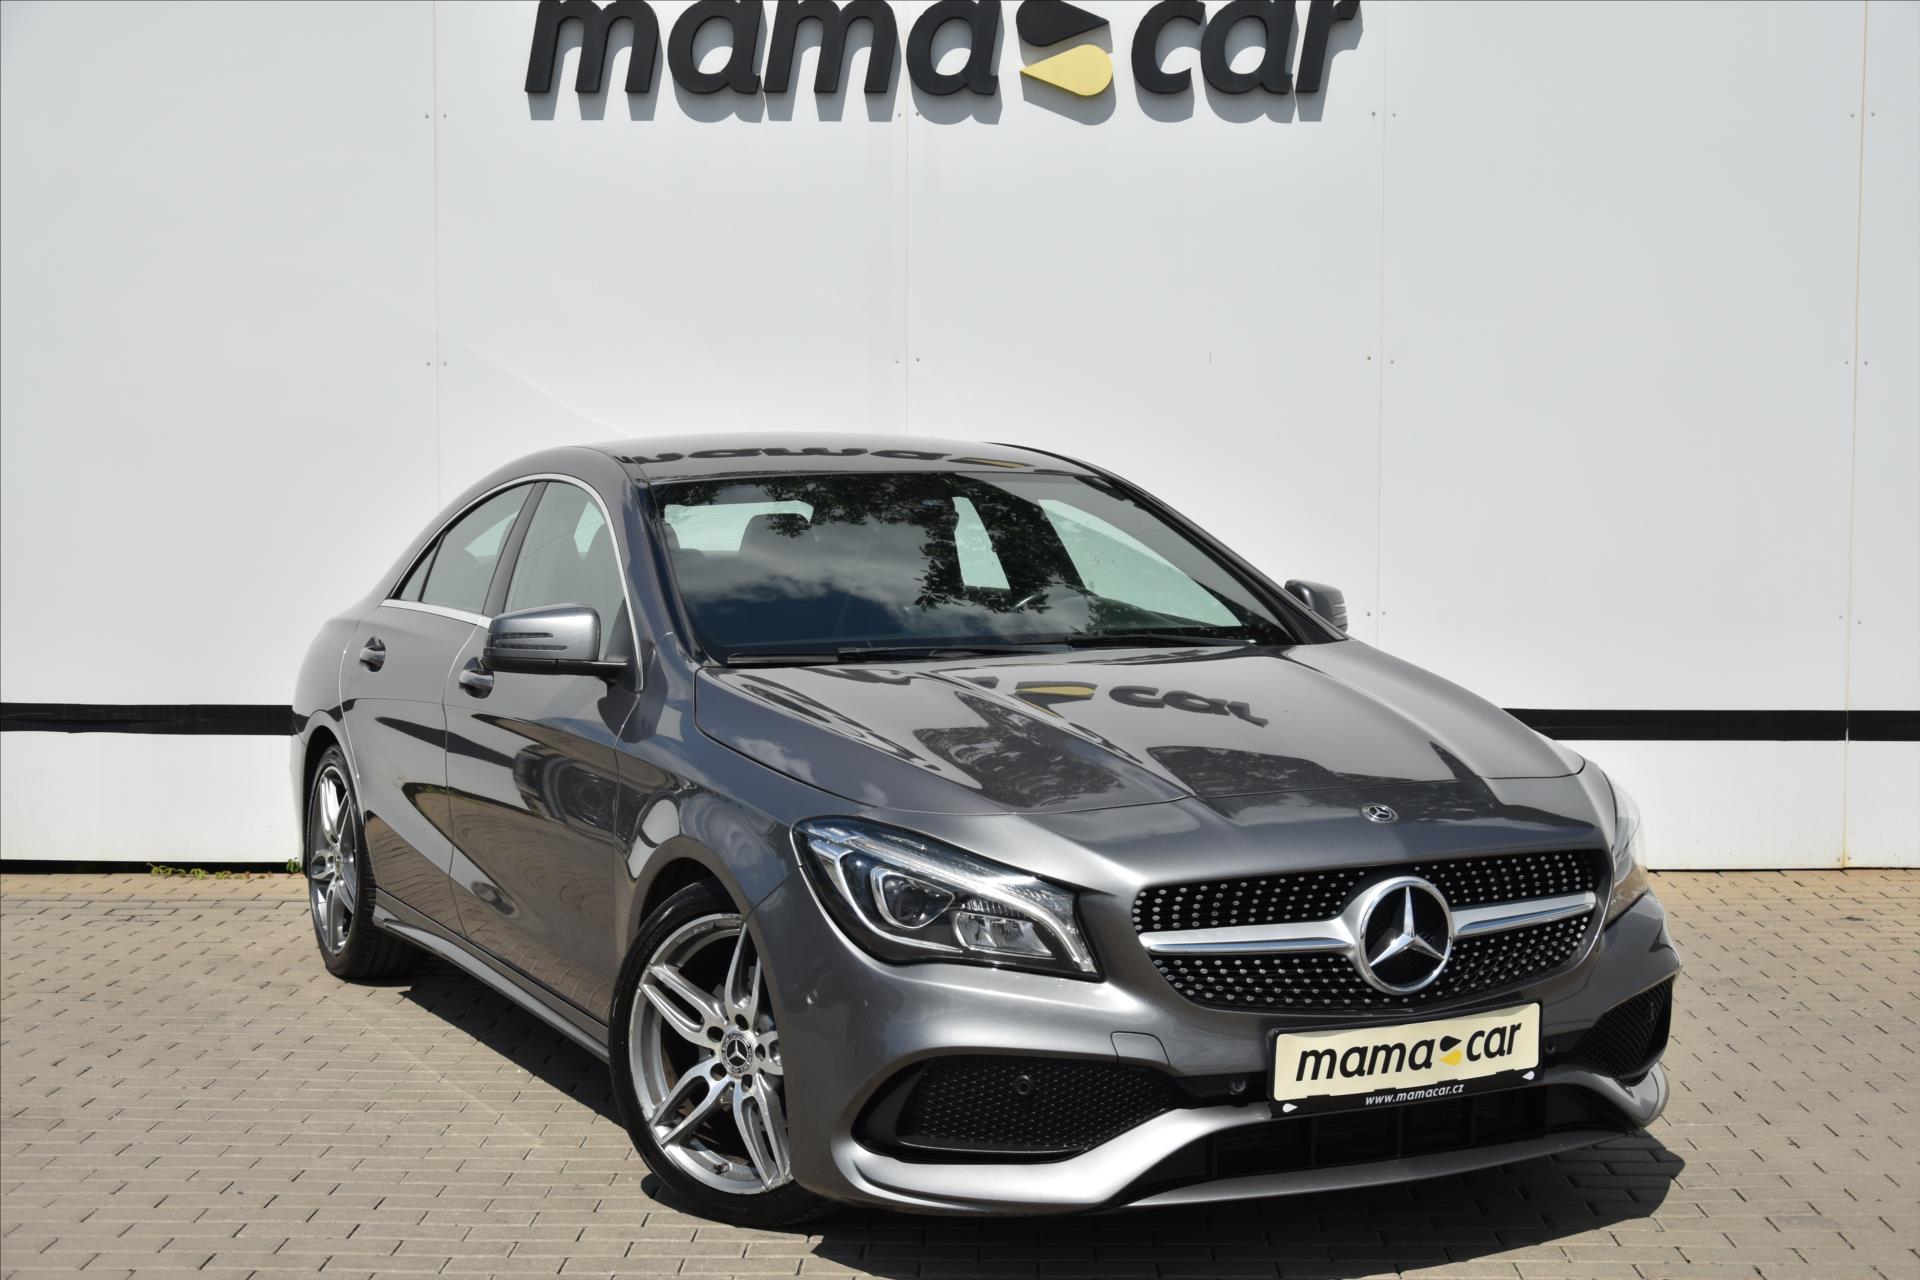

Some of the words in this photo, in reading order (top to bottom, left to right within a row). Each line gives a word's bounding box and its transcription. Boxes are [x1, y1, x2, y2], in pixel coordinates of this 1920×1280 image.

[525, 0, 998, 95] mama
[1131, 0, 1361, 94] car
[1295, 1038, 1436, 1082] mama
[1466, 1022, 1522, 1062] car
[1365, 1083, 1465, 1106] www.mamacar.cz
